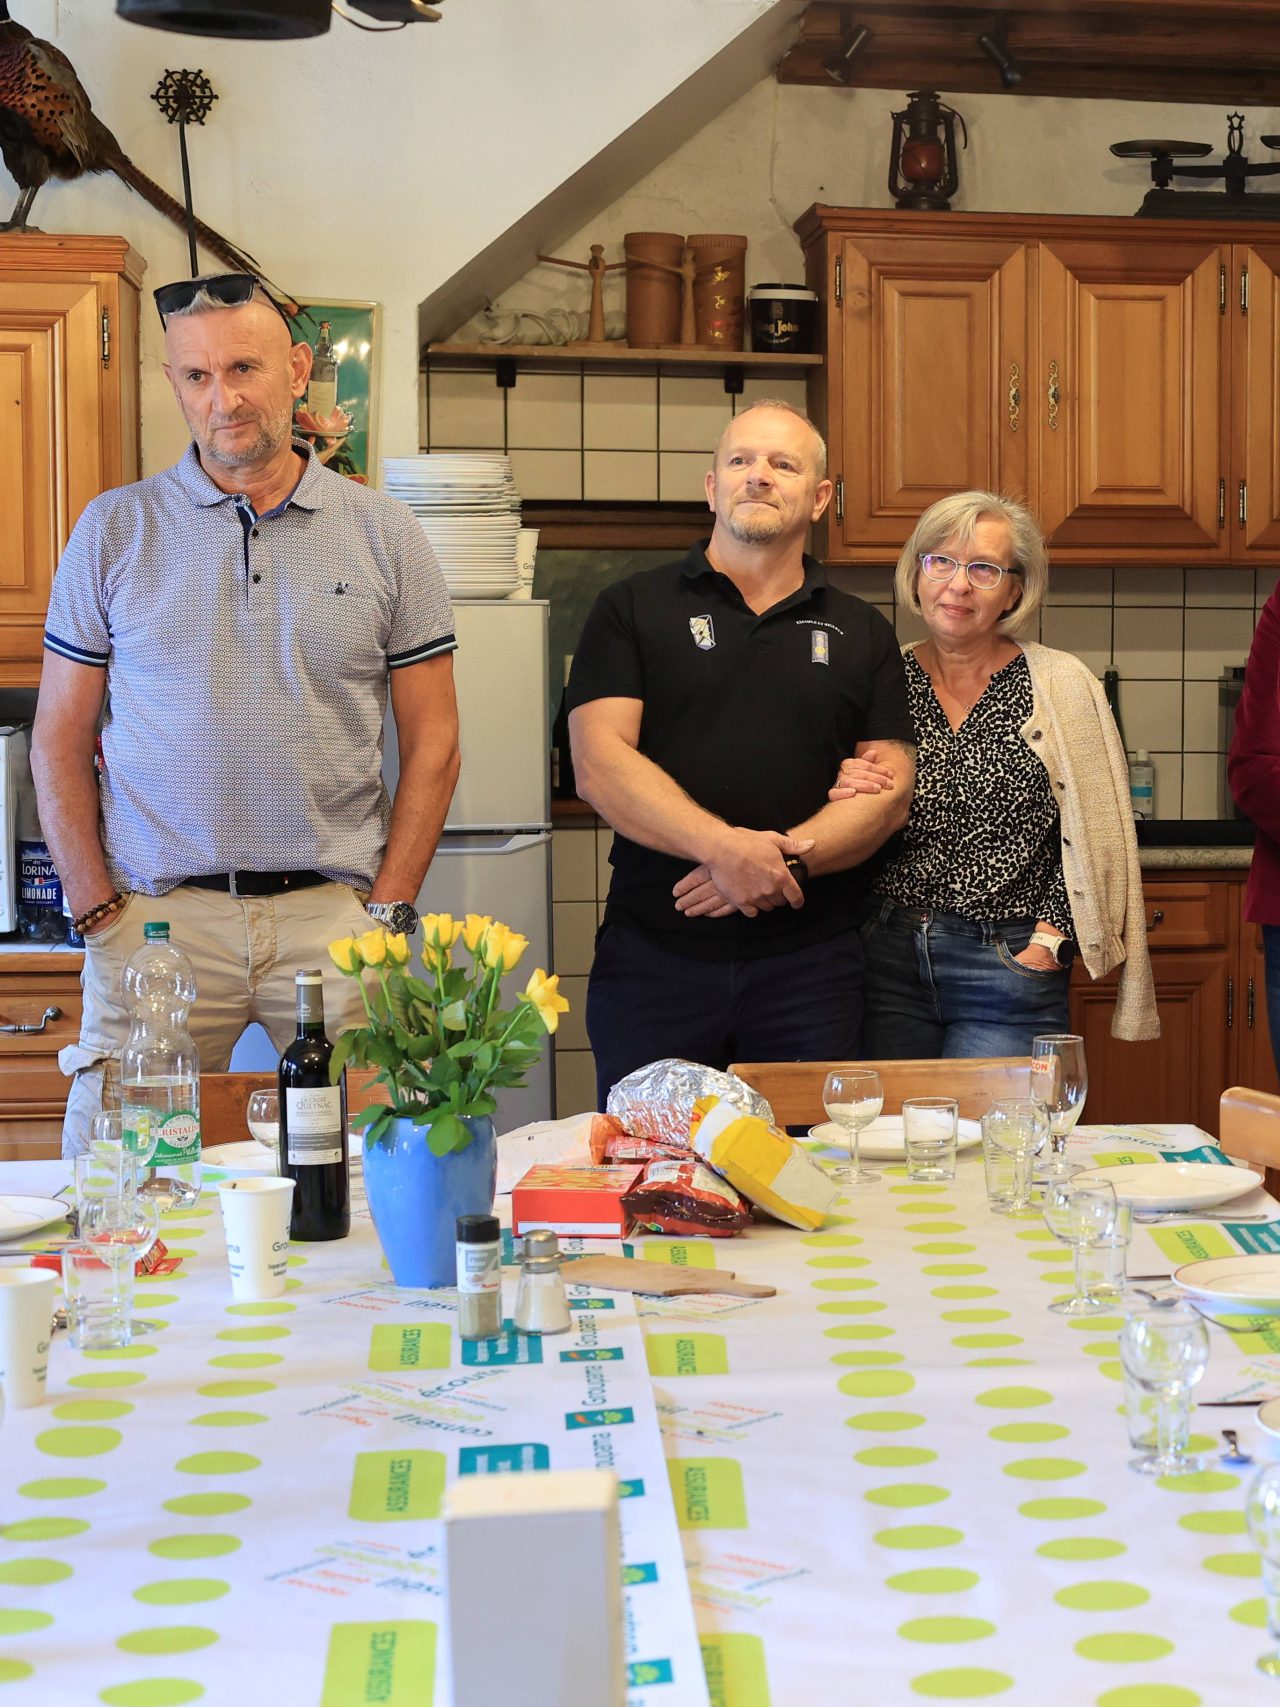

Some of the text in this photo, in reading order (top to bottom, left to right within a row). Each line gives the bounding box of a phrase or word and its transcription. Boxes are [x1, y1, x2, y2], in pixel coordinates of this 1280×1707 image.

[21, 862, 58, 876] LORINA
[21, 887, 57, 900] LIMONADE
[155, 1123, 200, 1138] RISTALIN
[400, 1329, 422, 1366] ASSURANCES
[581, 1365, 611, 1406] Groupama
[385, 1459, 412, 1512] ASSURANCES
